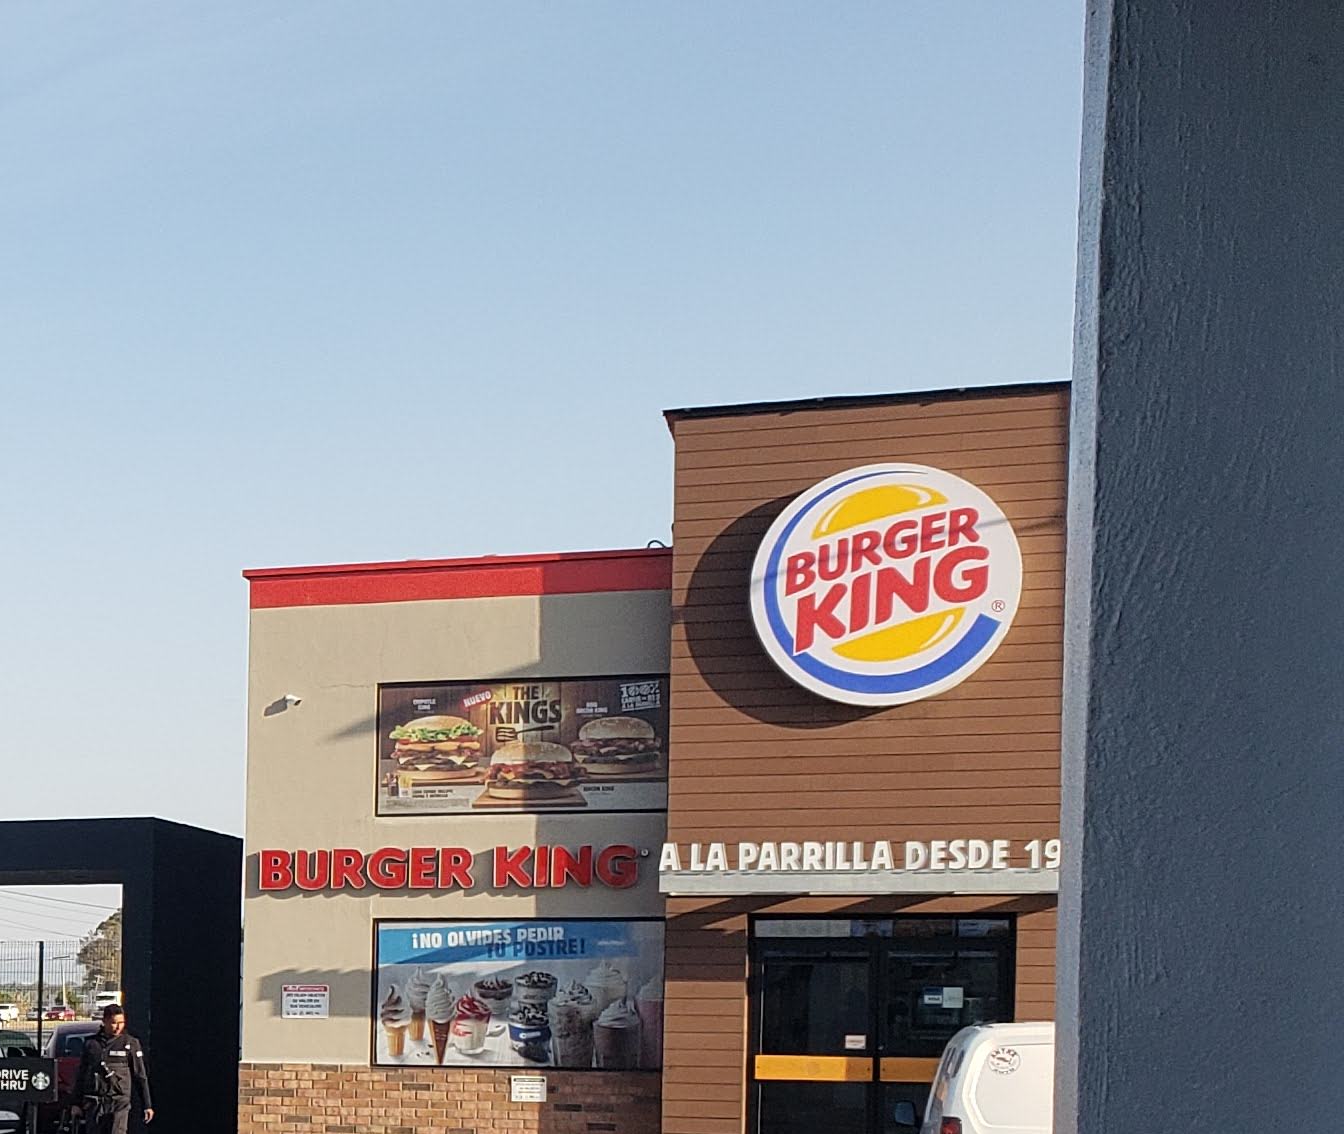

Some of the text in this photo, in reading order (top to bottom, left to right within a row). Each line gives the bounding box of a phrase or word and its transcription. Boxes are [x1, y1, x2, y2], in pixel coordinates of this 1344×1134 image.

[784, 507, 981, 597] BURGER
[794, 544, 991, 654] KING
[463, 690, 492, 708] NUEVO
[512, 686, 540, 700] THE
[489, 699, 562, 725] KINGS
[258, 843, 641, 892] BURGER KING
[658, 838, 1062, 872] A LA PARRILLA DESDE 19
[412, 926, 565, 949] ¡NO OLVIDES PEDIR
[486, 937, 586, 959] TU POSTRE!
